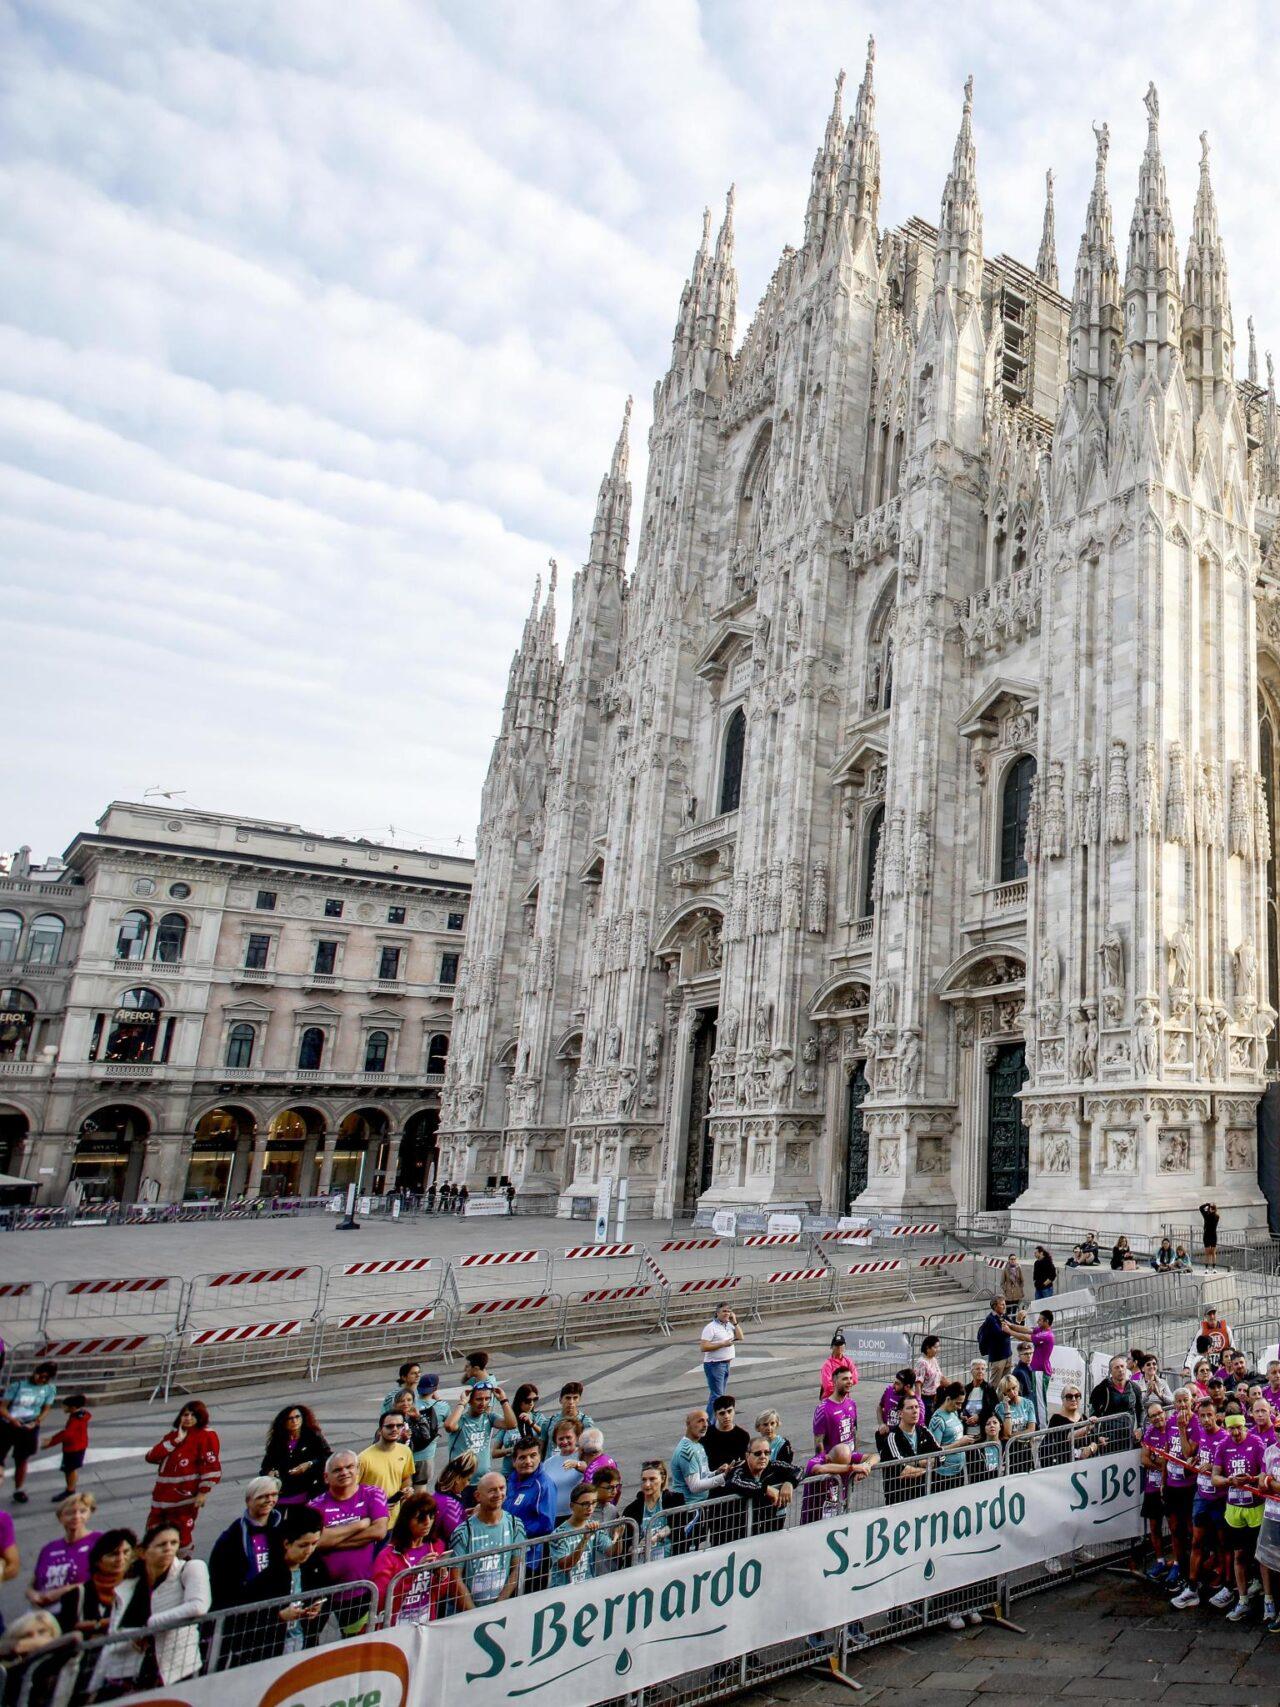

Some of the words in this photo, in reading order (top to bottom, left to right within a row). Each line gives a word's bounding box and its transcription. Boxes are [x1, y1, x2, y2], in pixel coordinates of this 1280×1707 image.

[858, 1339, 886, 1350] DUOMO
[470, 1431, 485, 1440] DEE
[1232, 1459, 1246, 1468] DEE
[256, 1552, 269, 1564] EE
[408, 1580, 431, 1595] JAY
[405, 1595, 421, 1605] TEN
